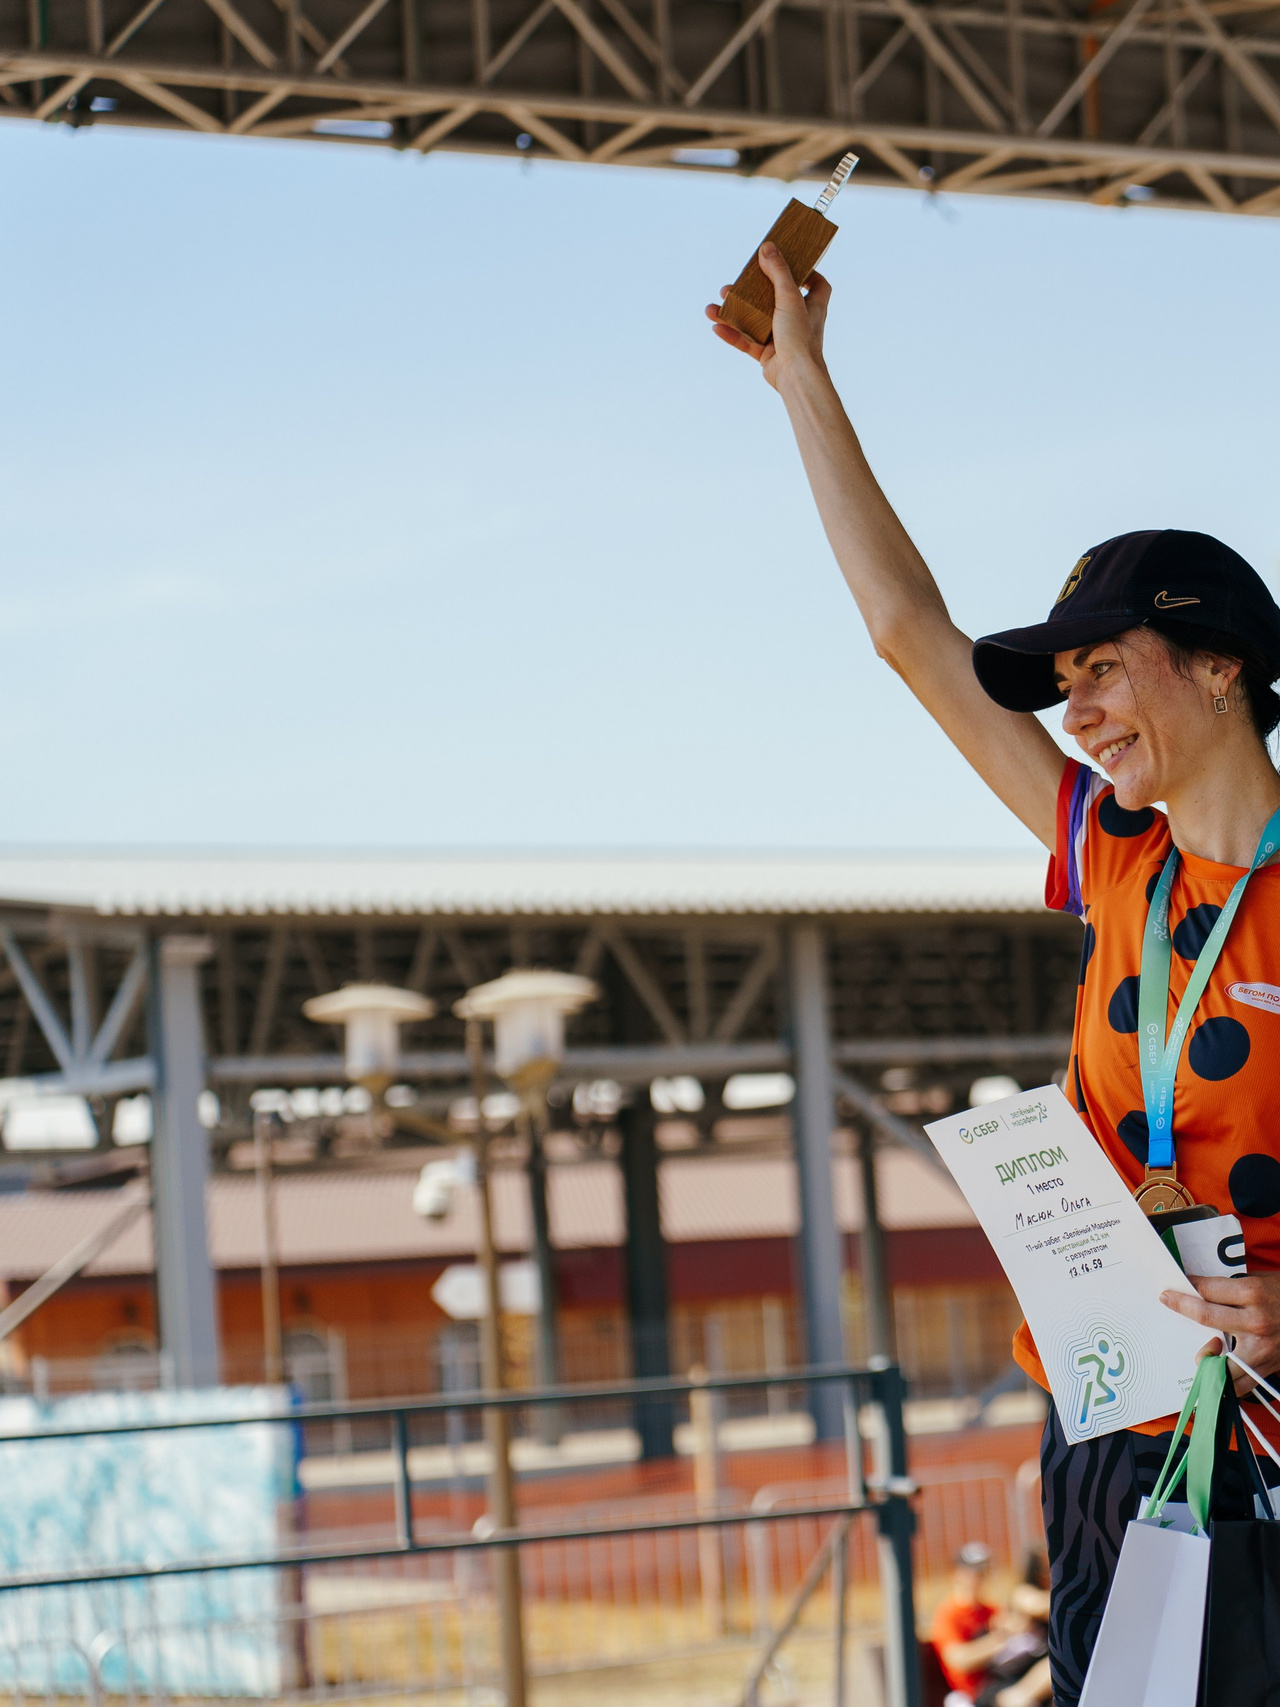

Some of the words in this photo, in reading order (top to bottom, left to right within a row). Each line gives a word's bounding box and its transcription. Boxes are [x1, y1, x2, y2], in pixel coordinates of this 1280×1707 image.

[1238, 986, 1265, 997] БЕГОМ
[1266, 993, 1280, 1002] ПО
[1148, 1037, 1157, 1065] СБЕР
[1158, 1086, 1166, 1115] СБЕР
[973, 1120, 1000, 1138] СБЕР
[995, 1146, 1069, 1186] ДИПЛОМ
[1026, 1183, 1035, 1195] 1
[1035, 1177, 1064, 1193] место
[1025, 1240, 1044, 1253] 11-ый
[1044, 1236, 1061, 1247] забег
[1057, 1239, 1090, 1255] дистанции
[1089, 1233, 1101, 1243] 4,2
[1101, 1231, 1110, 1240] км
[1069, 1243, 1109, 1262] результатом
